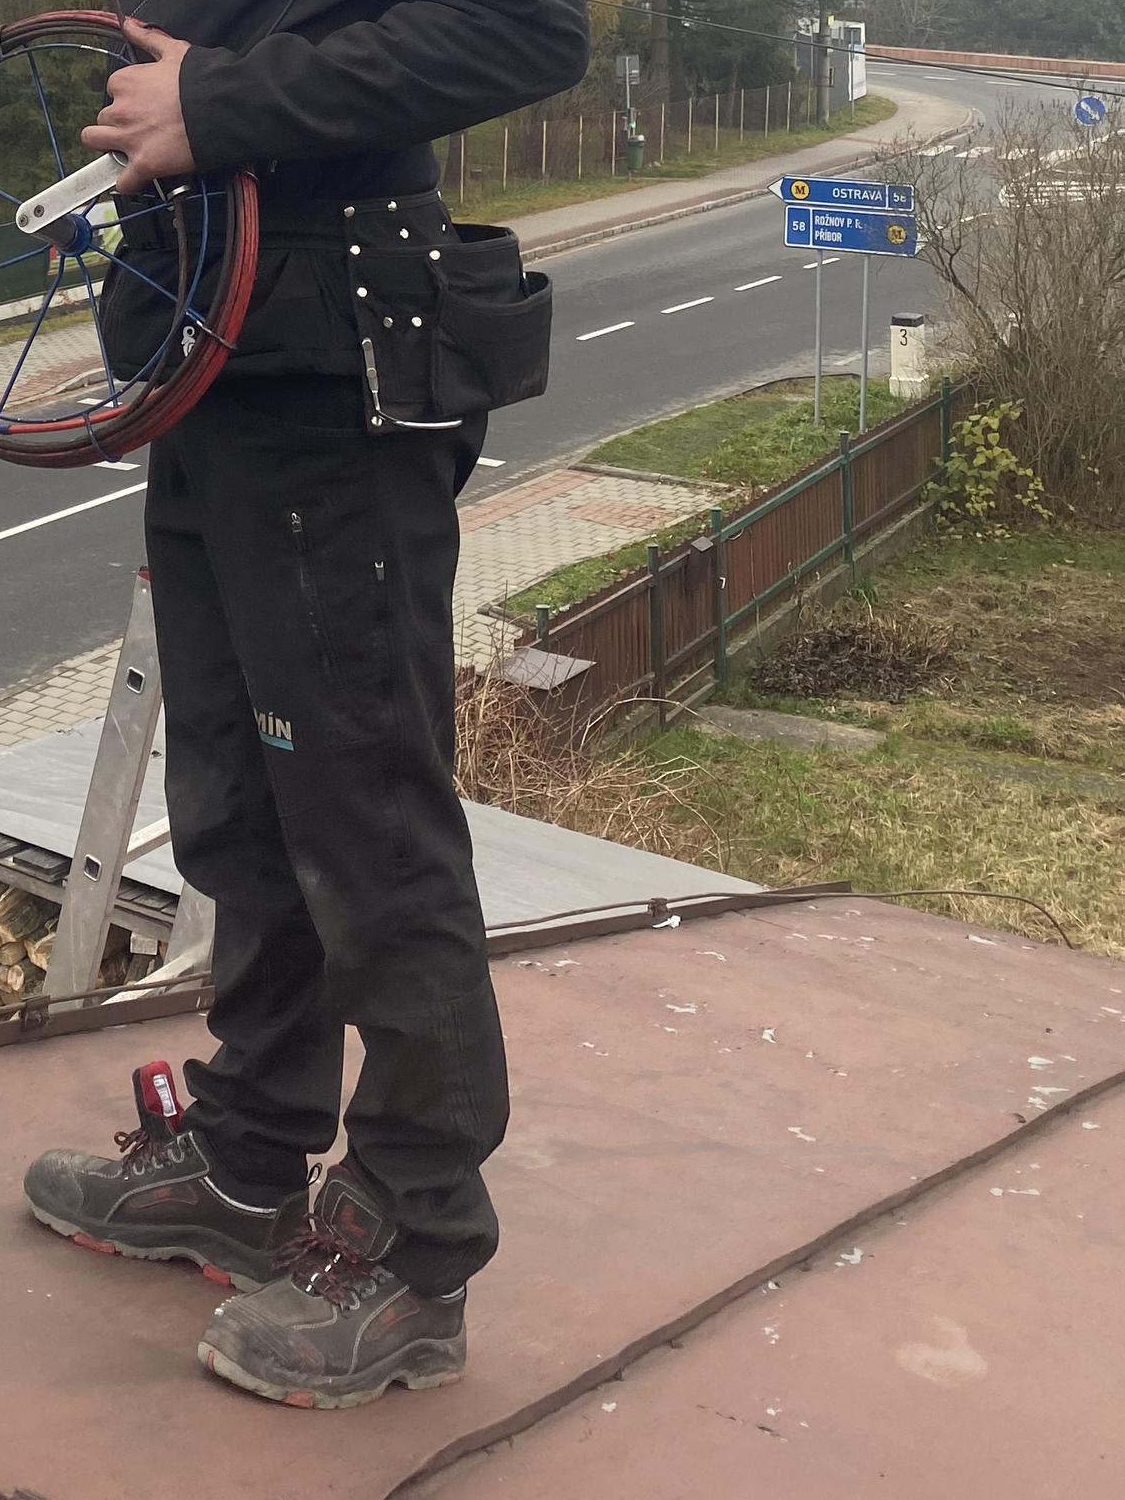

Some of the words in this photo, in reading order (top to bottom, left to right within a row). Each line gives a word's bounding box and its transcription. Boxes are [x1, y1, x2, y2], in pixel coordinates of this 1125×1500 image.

[794, 185, 806, 195] M
[832, 187, 883, 201] OSTRAVA
[792, 220, 806, 232] 58
[814, 213, 844, 228] ROŽNOV
[846, 219, 853, 228] P.
[814, 228, 843, 243] PŘÍBOR
[899, 328, 908, 347] 3
